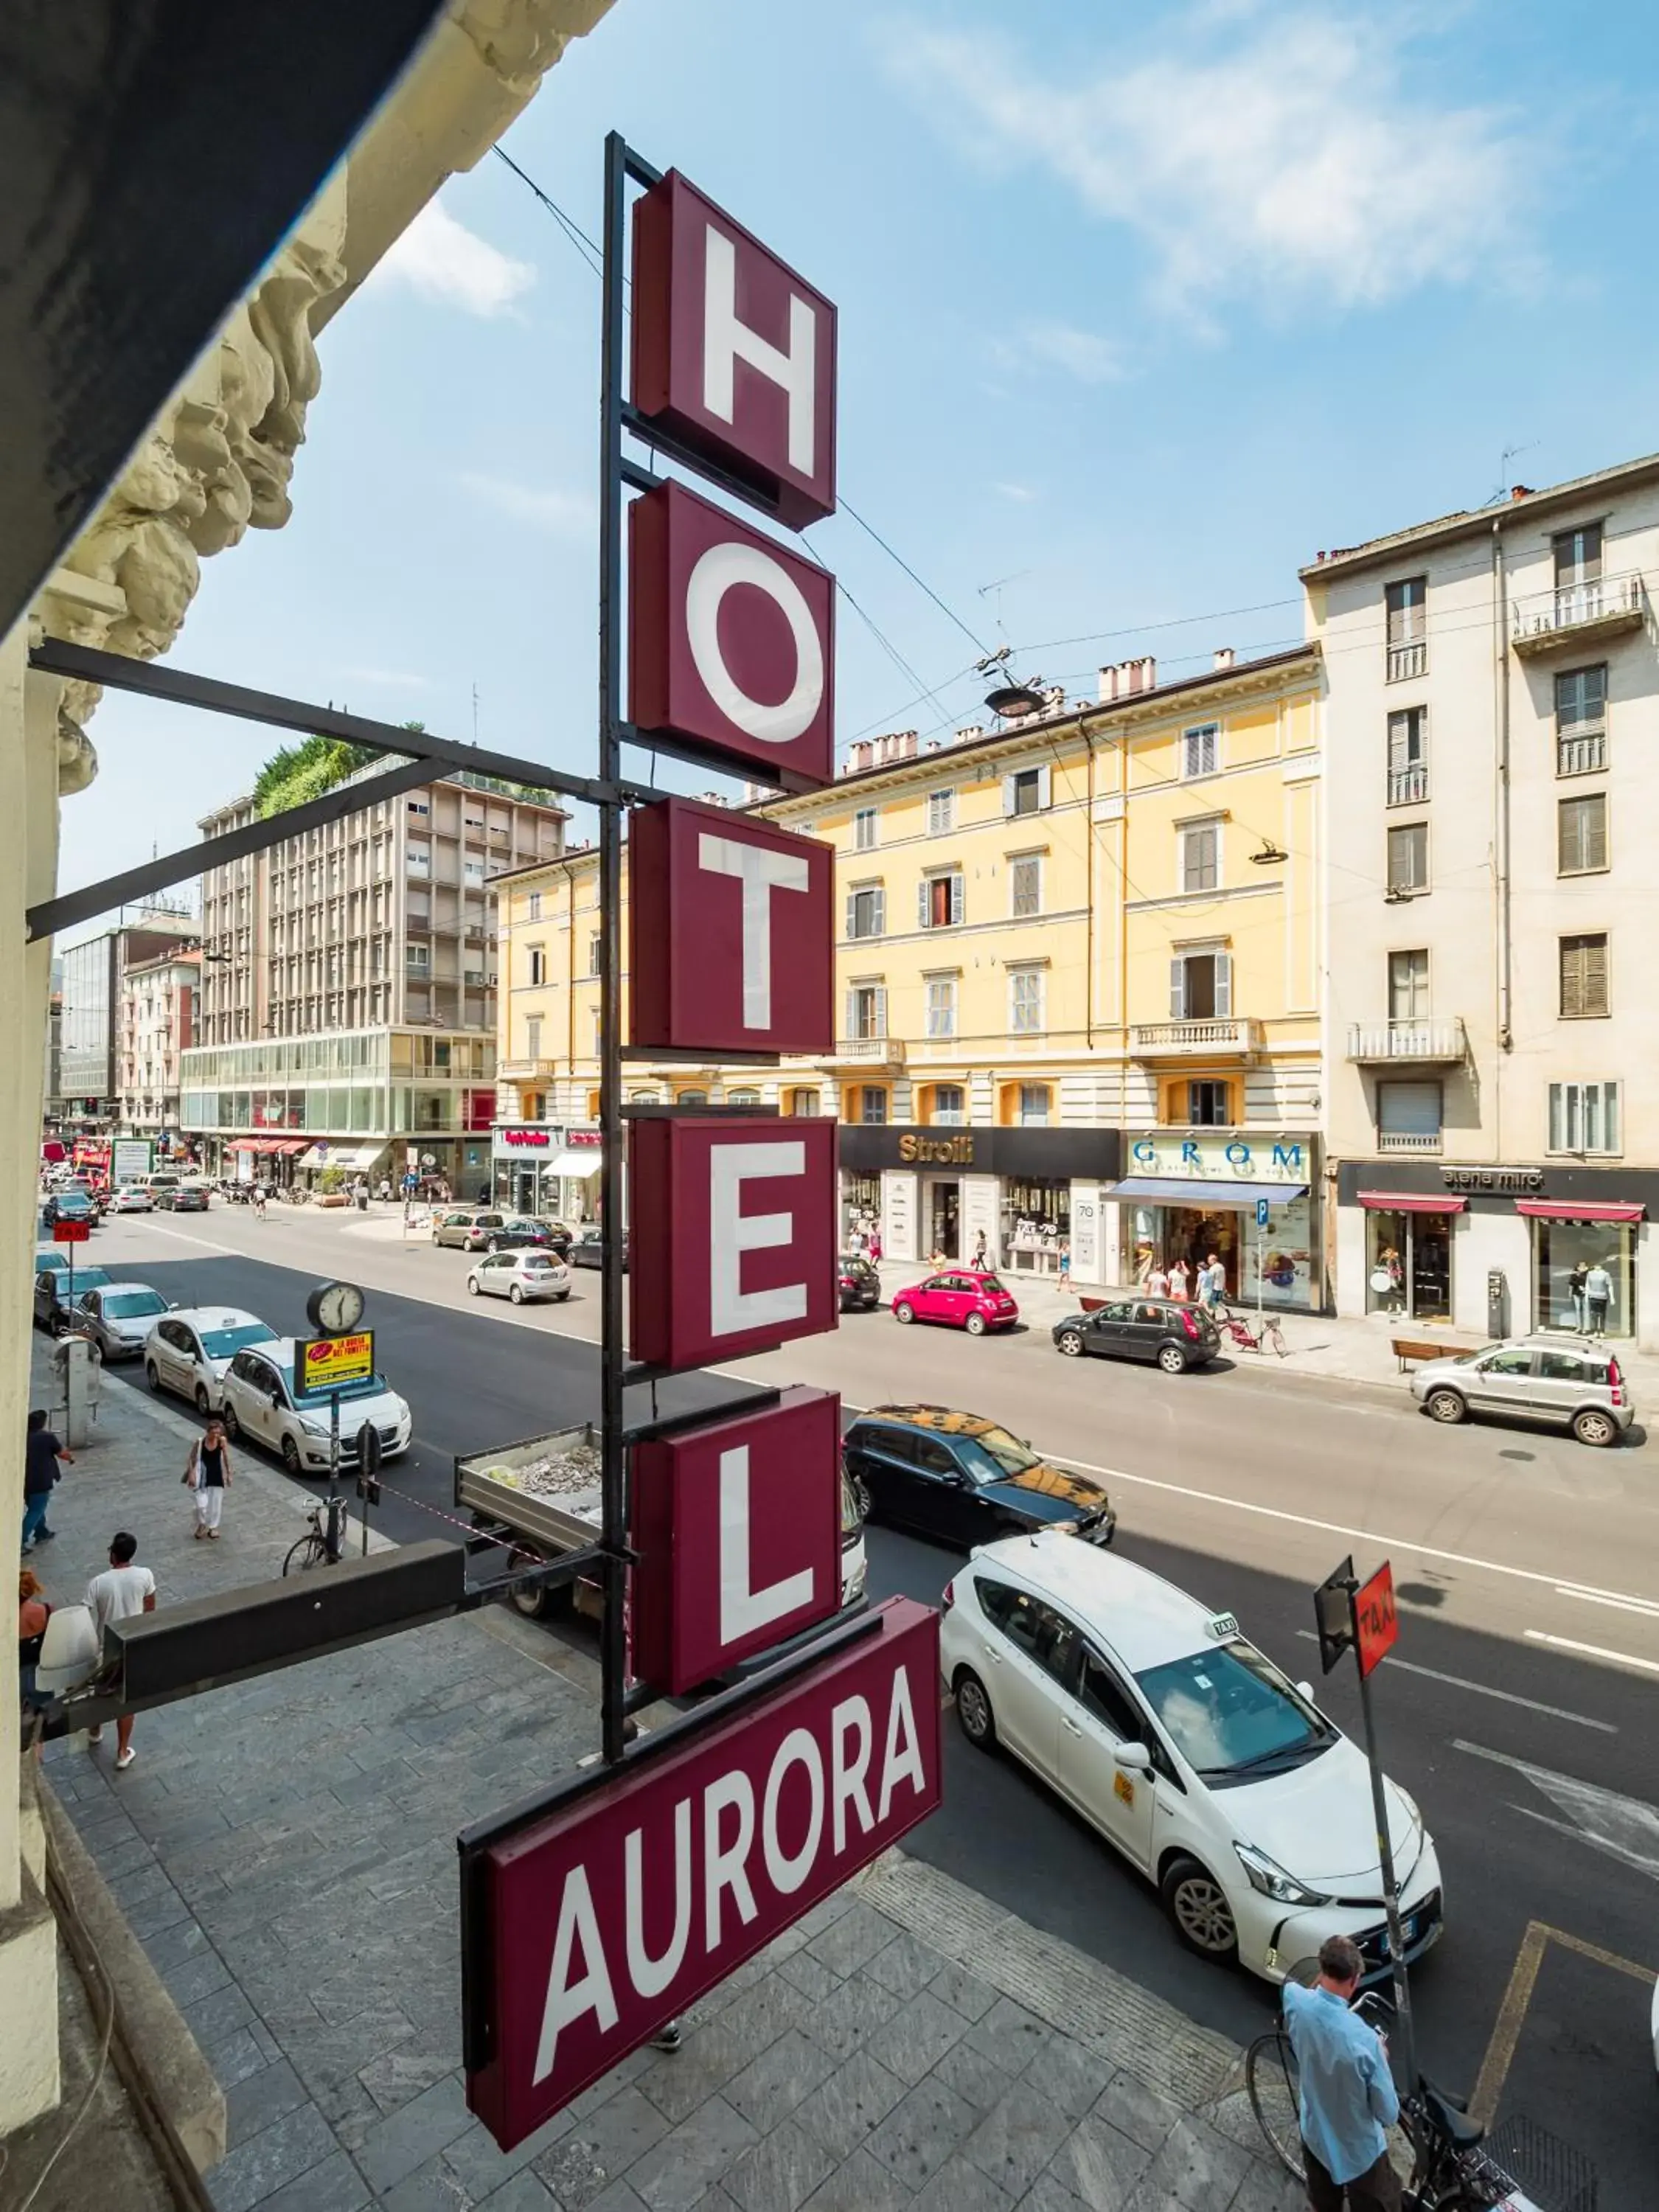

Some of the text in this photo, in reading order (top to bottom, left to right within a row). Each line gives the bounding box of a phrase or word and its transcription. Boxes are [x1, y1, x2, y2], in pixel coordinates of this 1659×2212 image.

[686, 223, 824, 1646] HOTEL
[1133, 1141, 1301, 1166] GROM
[1214, 1618, 1237, 1635] TAXI
[532, 1665, 925, 2087] AURORA
